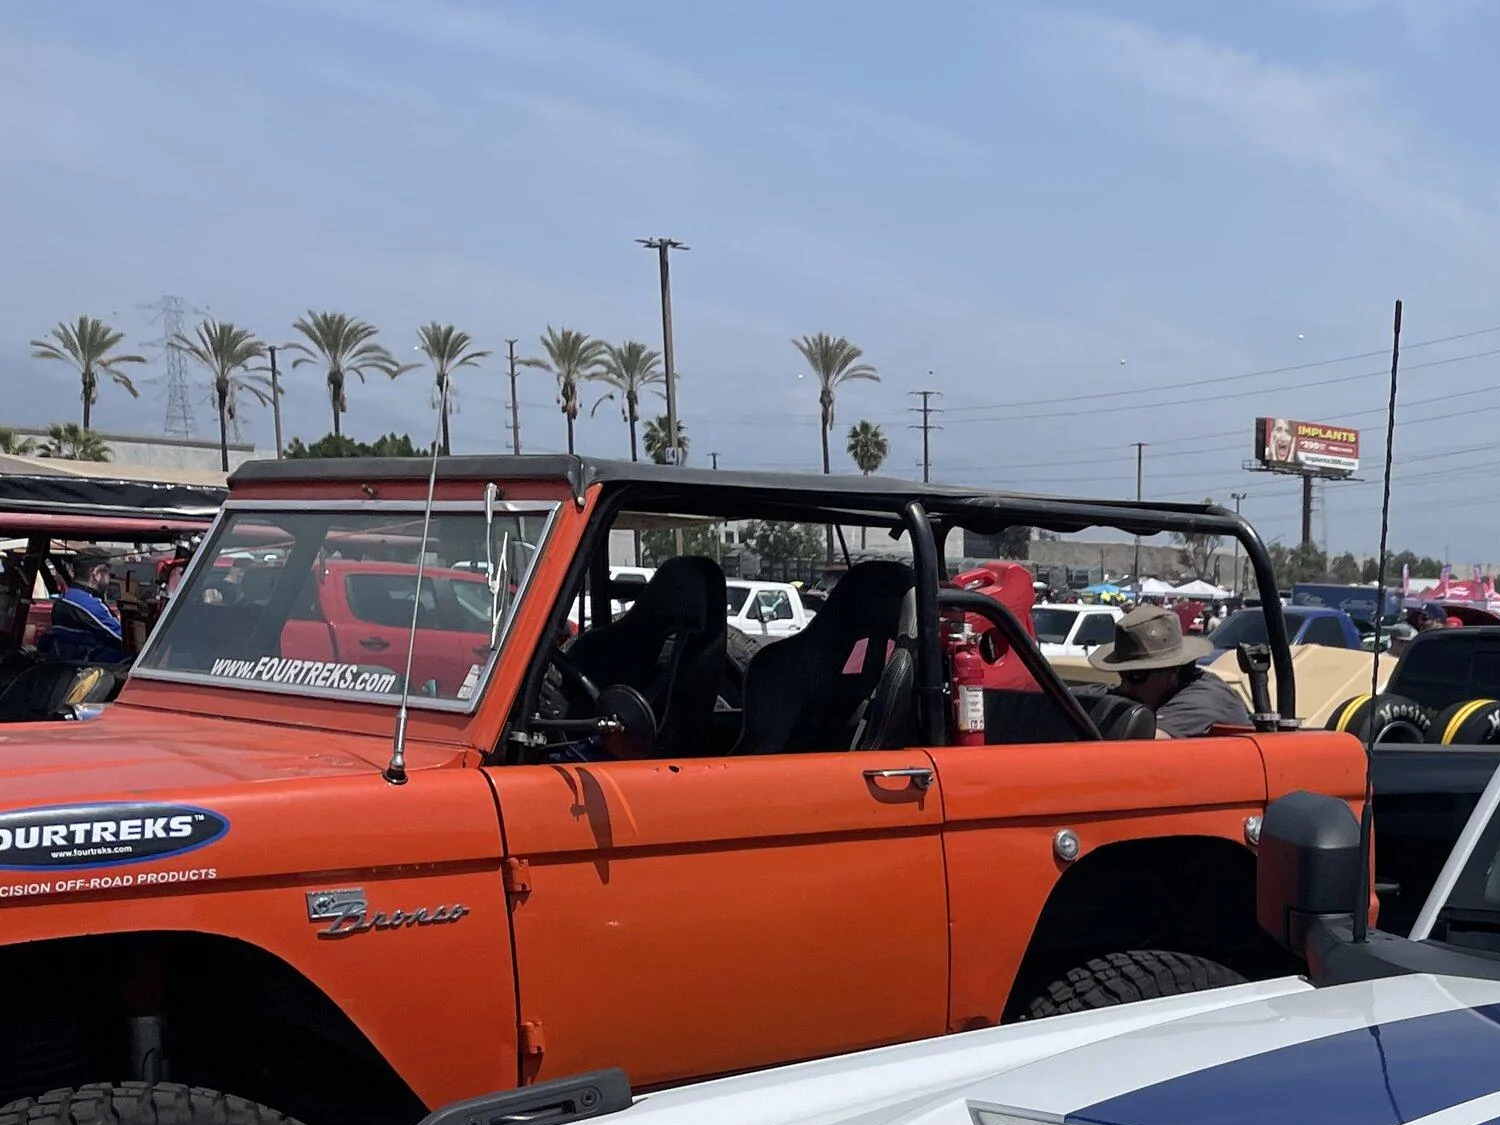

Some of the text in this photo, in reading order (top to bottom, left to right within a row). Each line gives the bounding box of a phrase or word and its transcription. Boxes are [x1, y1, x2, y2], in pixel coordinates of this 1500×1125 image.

[1298, 425, 1357, 443] IMPLANTS
[210, 656, 397, 694] www.FOURTREKS.com
[1380, 703, 1431, 729] Hoosier
[0, 814, 193, 851] URTREKS
[50, 845, 133, 859] www.fourtreks.com
[55, 874, 134, 893] OFF-ROAD
[136, 867, 218, 885] PRODUCTS
[316, 898, 471, 940] Bronco
